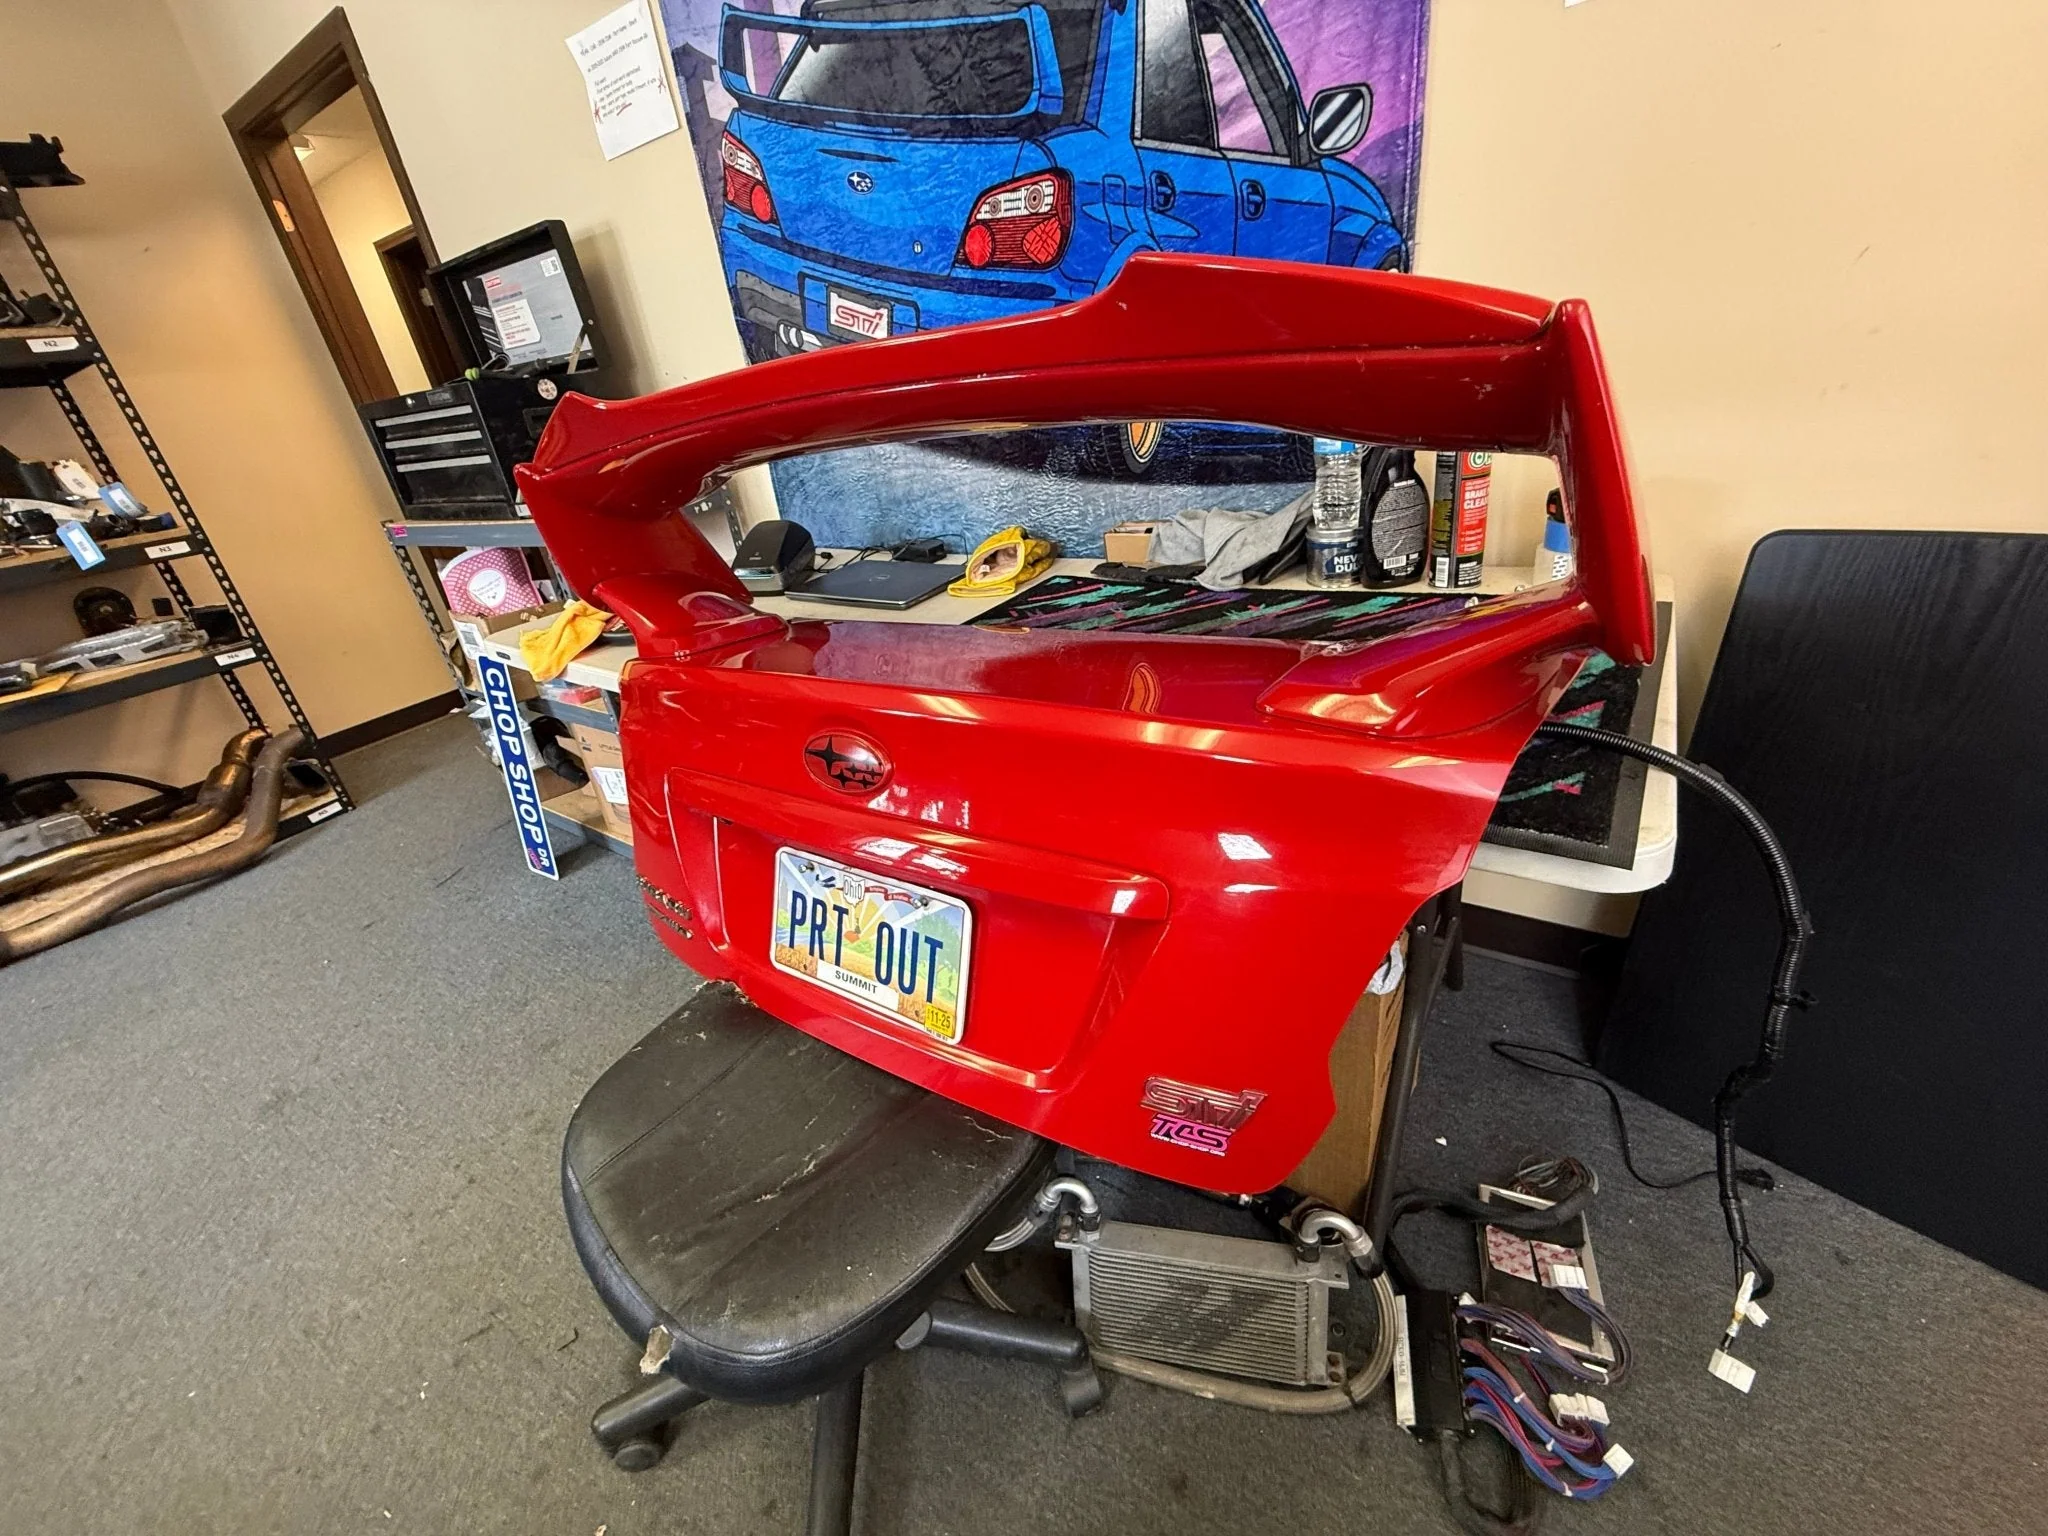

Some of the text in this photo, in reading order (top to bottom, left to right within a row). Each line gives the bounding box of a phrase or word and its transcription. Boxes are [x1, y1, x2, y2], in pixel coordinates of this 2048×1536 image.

[1464, 488, 1487, 500] BRAKE
[1334, 554, 1359, 566] NEV
[1335, 563, 1360, 574] DUL
[486, 667, 550, 868] CHOP SHOP DR
[844, 879, 863, 900] Ohio
[788, 890, 849, 967] PRT
[875, 921, 944, 1003] OUT
[834, 970, 878, 994] SUMMIT
[930, 1010, 951, 1029] 11-25
